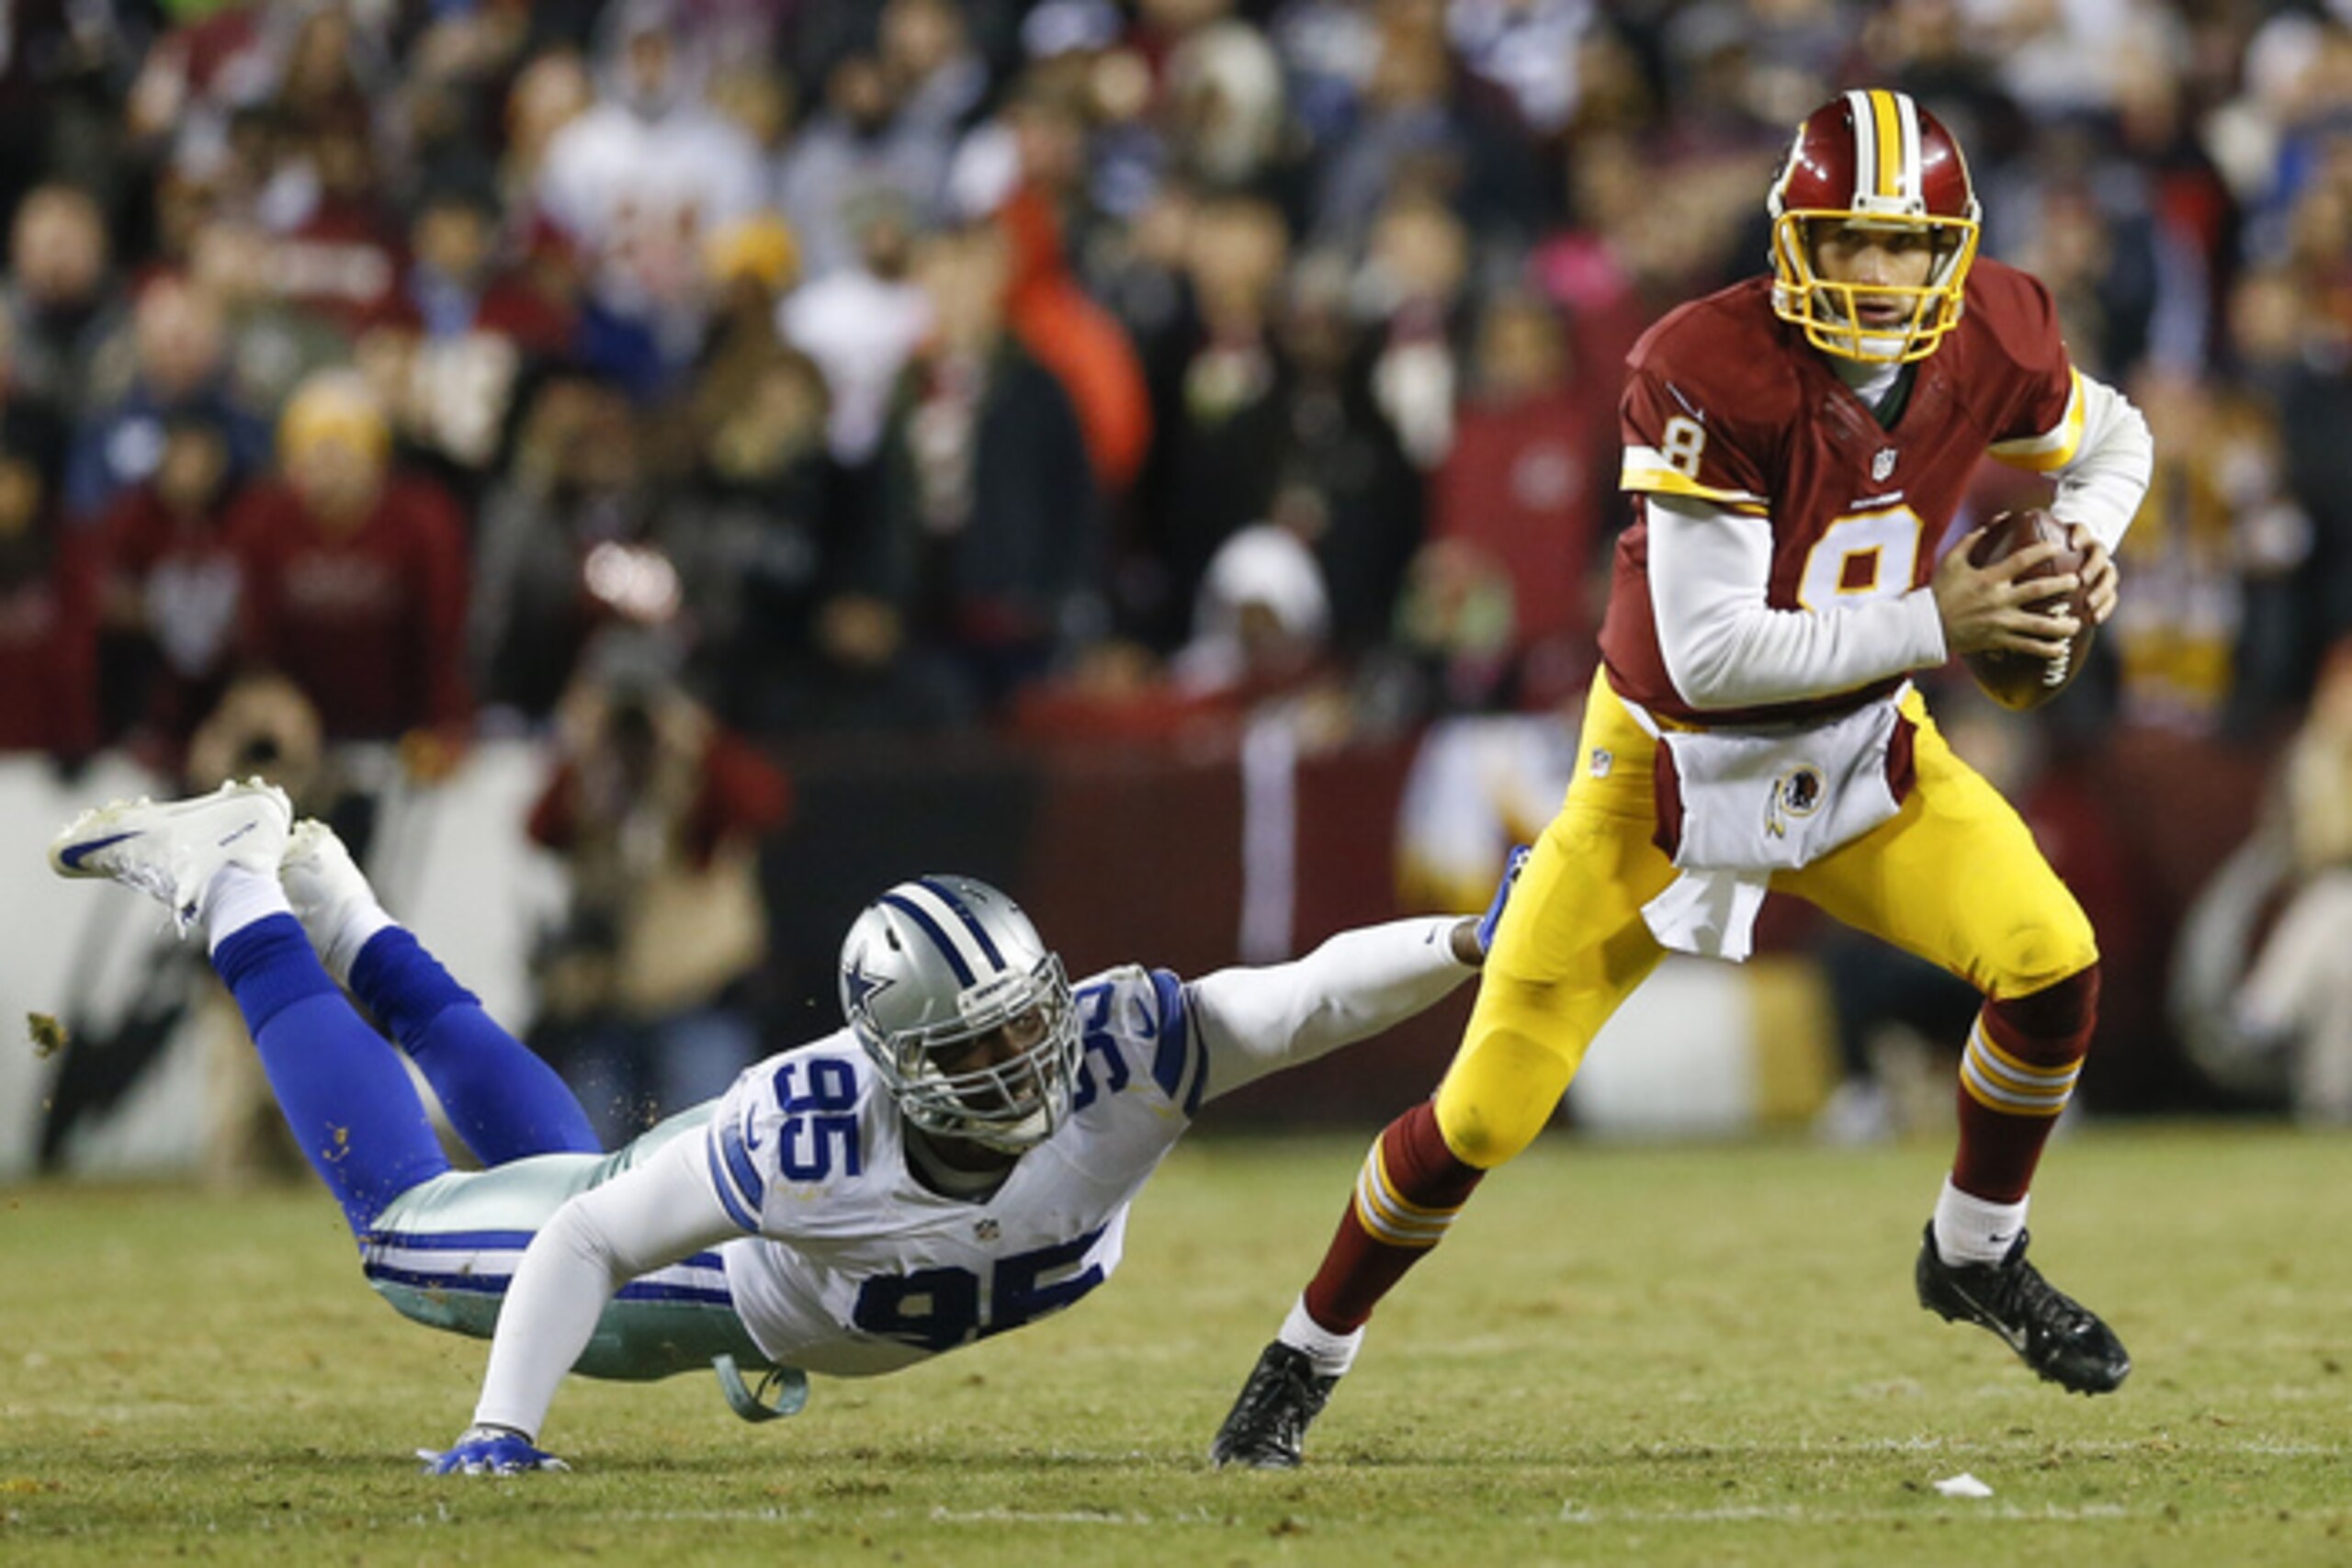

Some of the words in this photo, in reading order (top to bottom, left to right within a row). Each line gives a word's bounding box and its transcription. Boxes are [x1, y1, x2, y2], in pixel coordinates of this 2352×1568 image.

[1664, 416, 1706, 479] 8
[773, 1058, 862, 1181] 95
[853, 1222, 1104, 1352] 95
